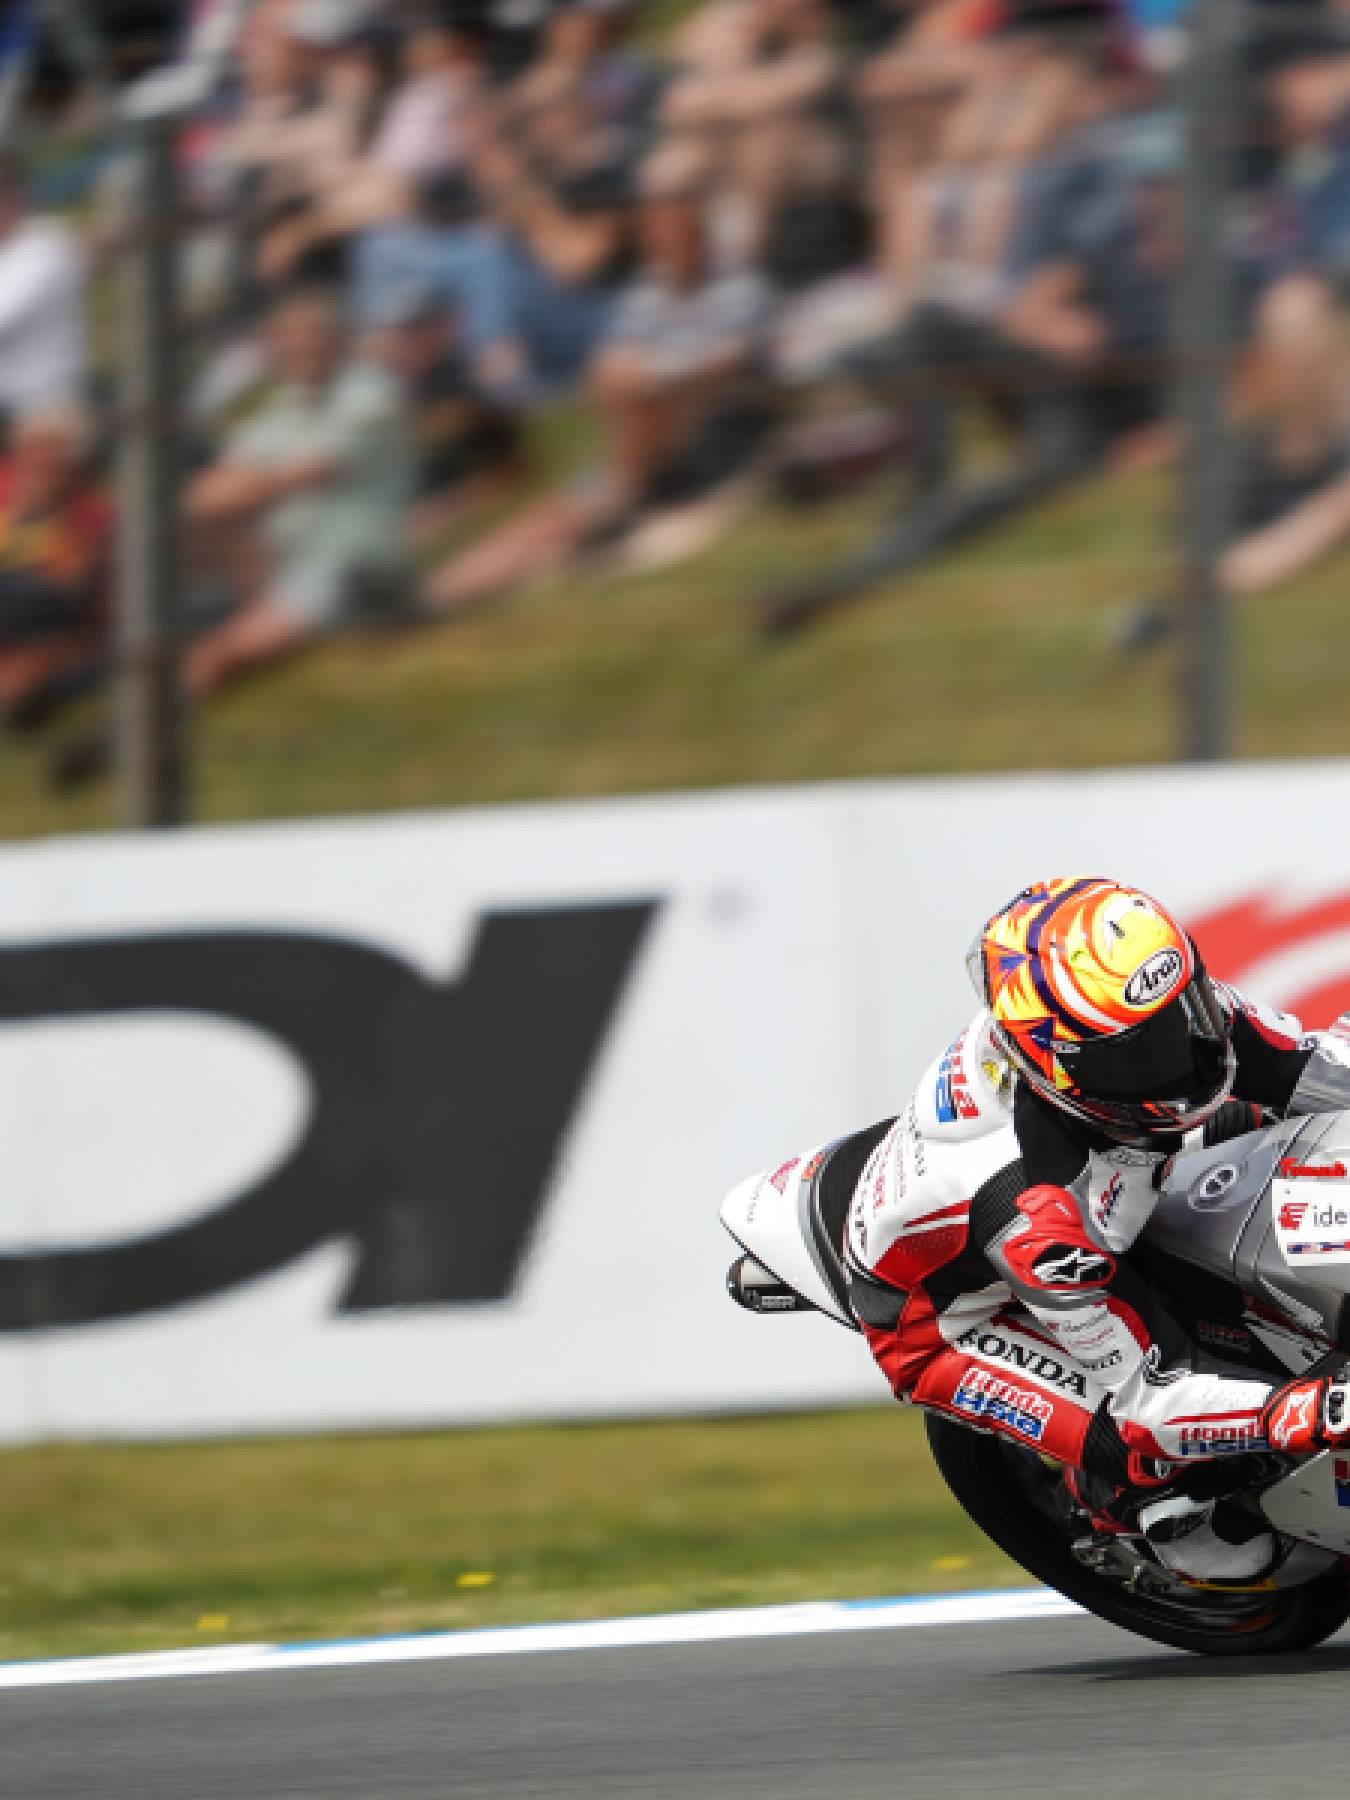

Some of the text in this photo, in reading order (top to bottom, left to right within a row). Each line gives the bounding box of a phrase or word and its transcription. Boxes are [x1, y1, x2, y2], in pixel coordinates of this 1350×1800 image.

[1134, 956, 1176, 997] Arai
[960, 1368, 1052, 1418] Honda
[1179, 1422, 1262, 1442] Hond
